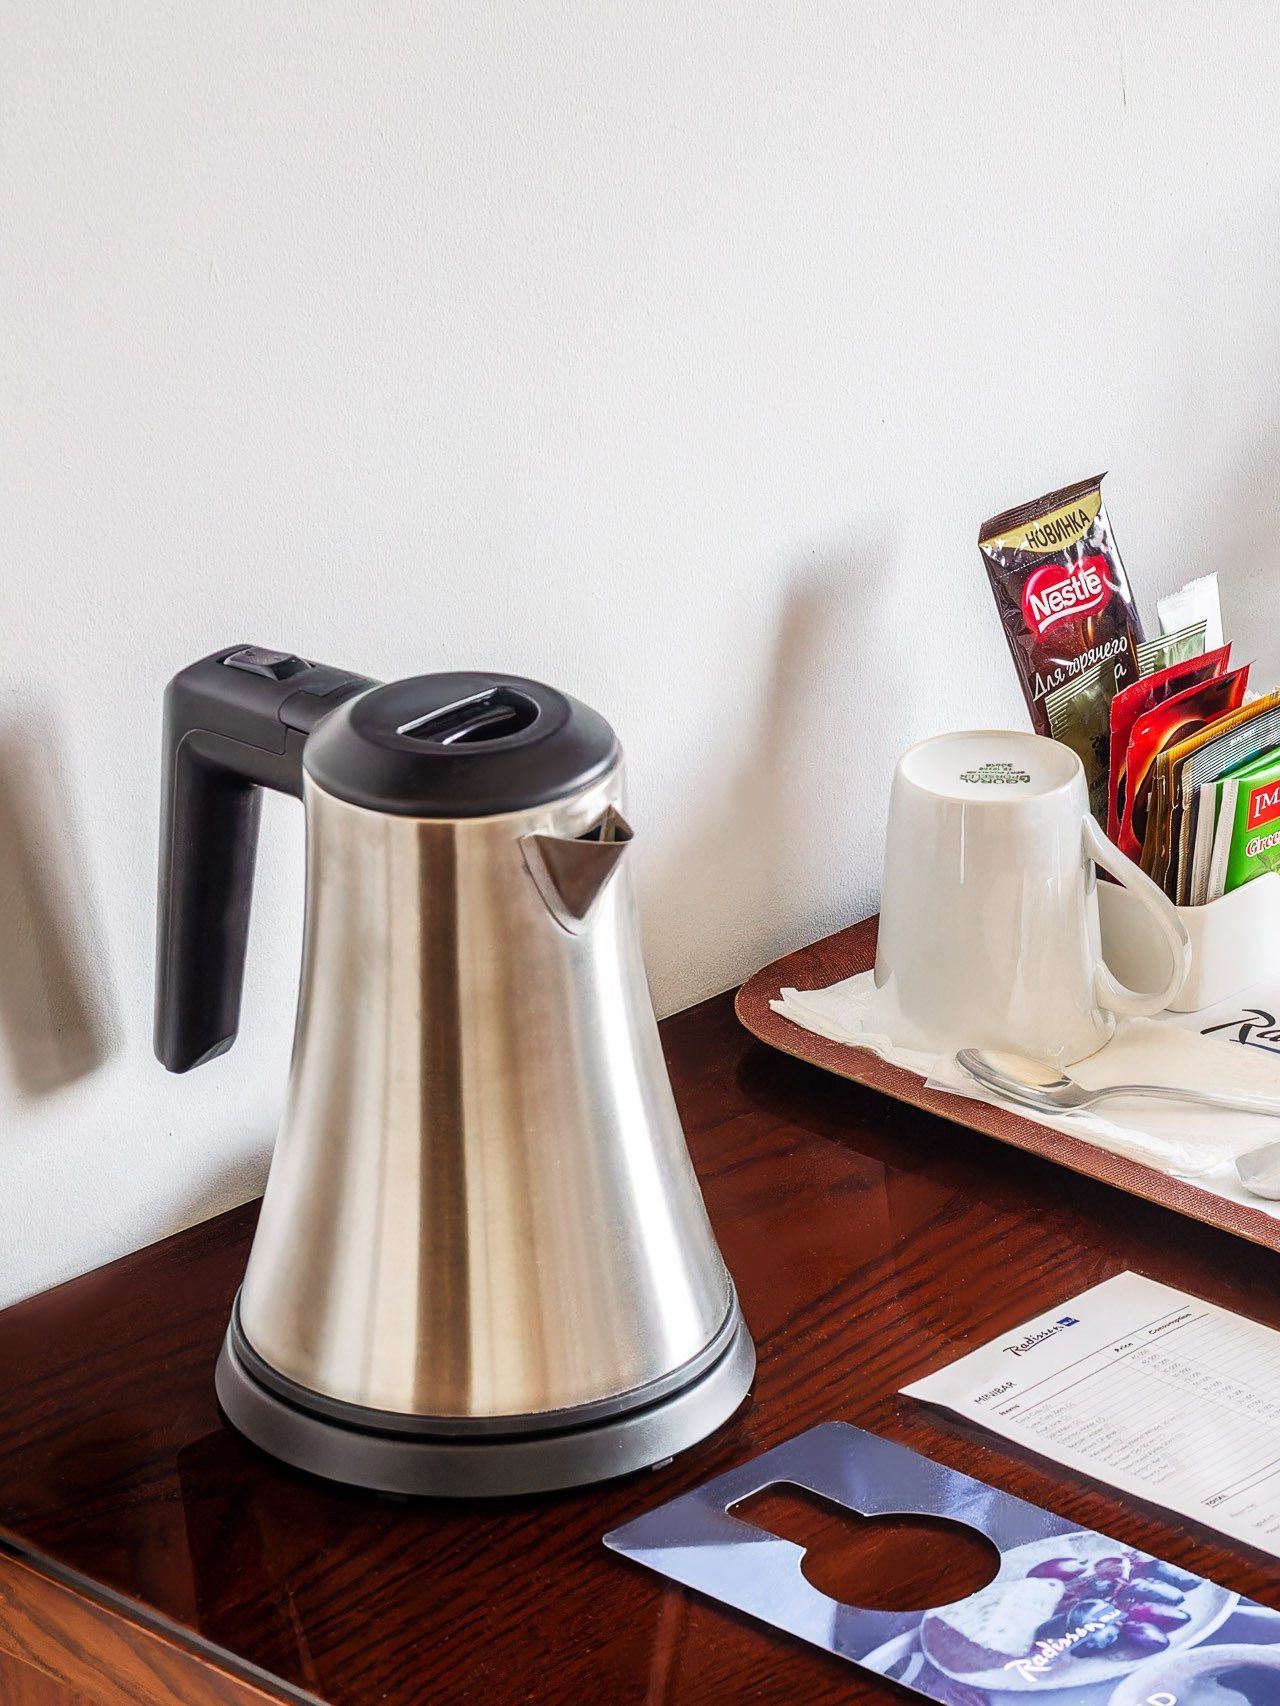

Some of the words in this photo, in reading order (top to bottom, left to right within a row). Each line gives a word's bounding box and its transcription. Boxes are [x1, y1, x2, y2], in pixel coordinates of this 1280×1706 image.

[1025, 508, 1091, 549] НОВИНКА
[1033, 668, 1066, 702] Для
[1002, 1324, 1065, 1357] Radisson
[973, 1380, 1018, 1406] MINIBAR
[1204, 1493, 1229, 1508] TOTAL
[1004, 1616, 1106, 1682] Radisson
